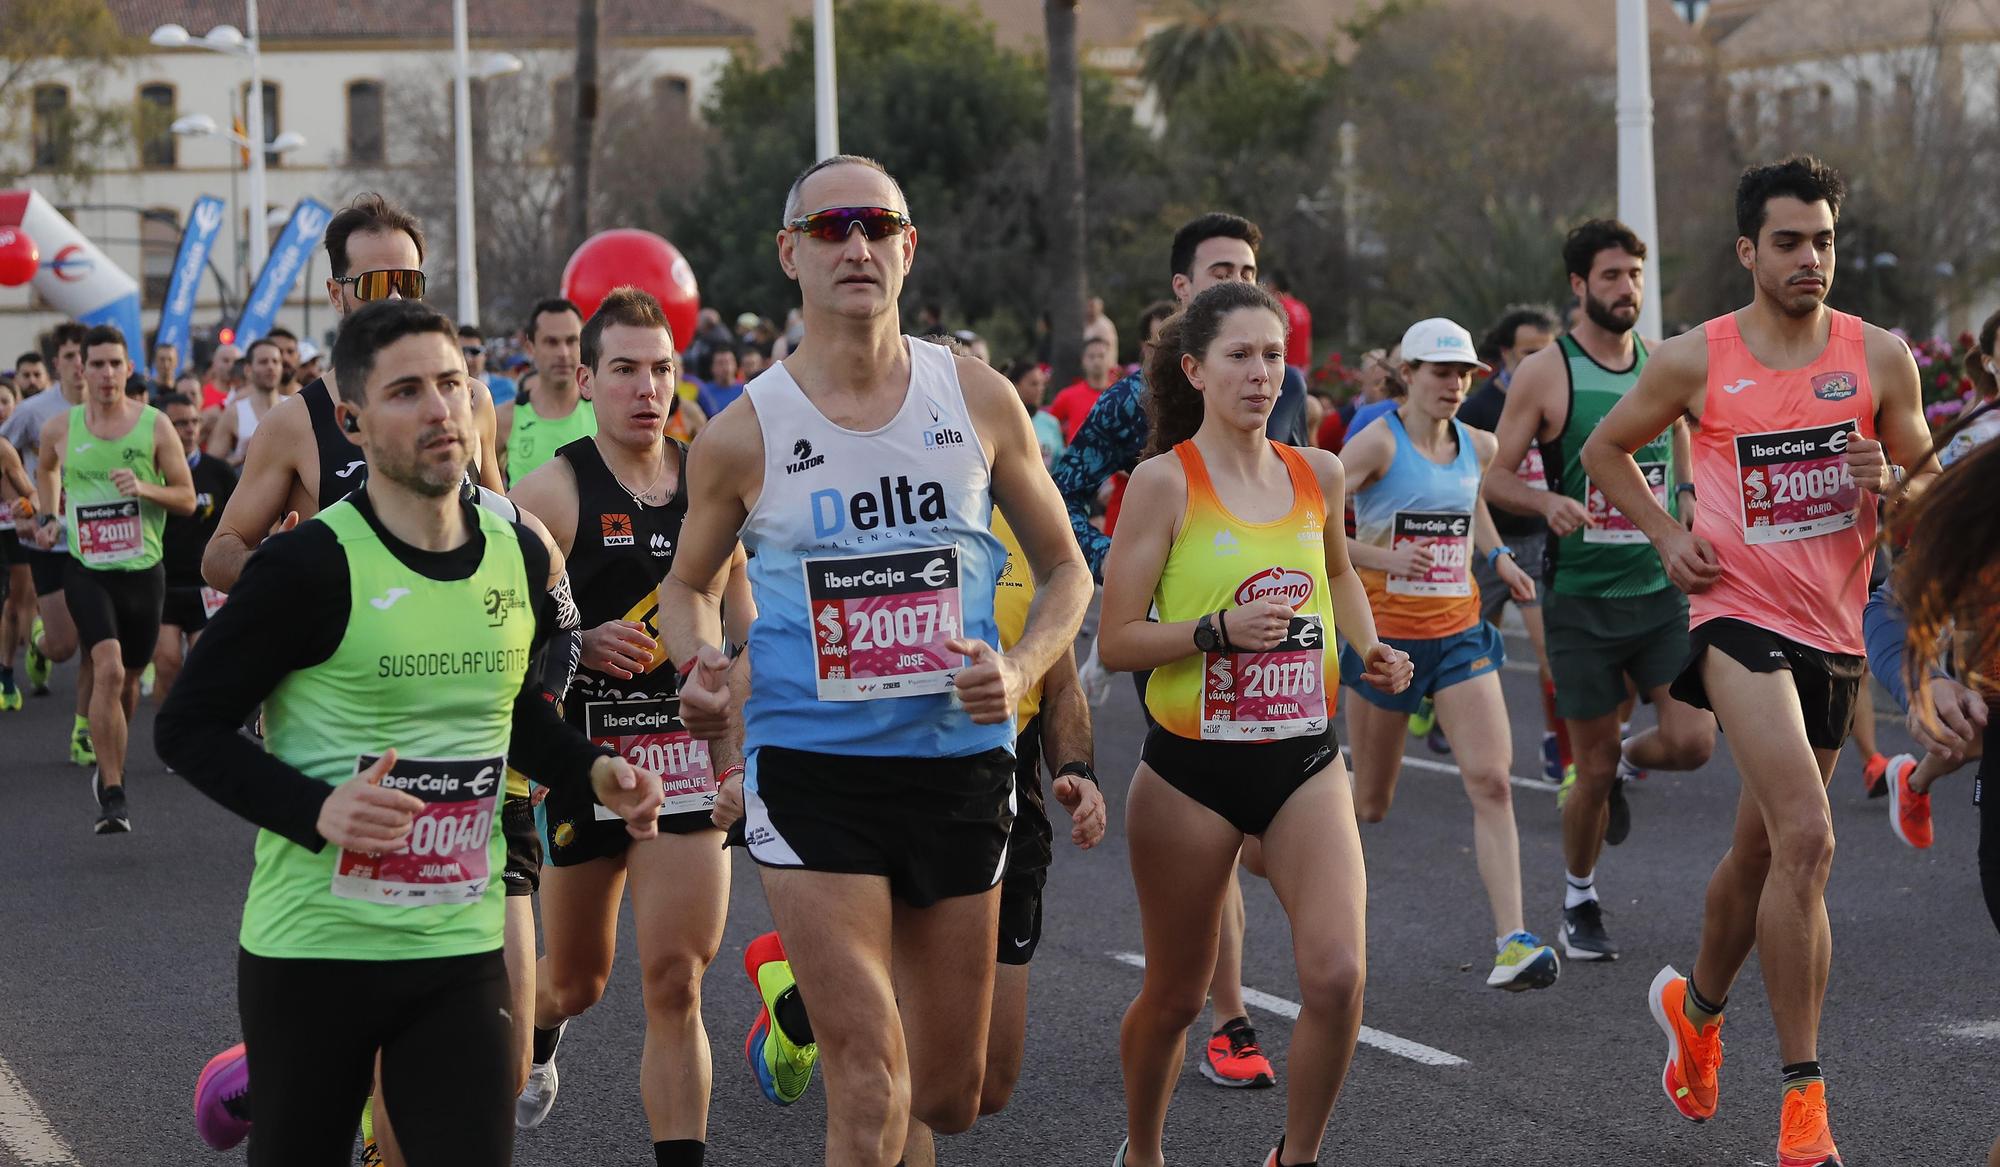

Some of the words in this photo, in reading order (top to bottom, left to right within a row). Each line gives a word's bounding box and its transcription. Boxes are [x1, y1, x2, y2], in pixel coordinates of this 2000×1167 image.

[923, 428, 963, 447] Delta
[1751, 439, 1815, 458] iberCaja
[786, 454, 825, 475] VIATOR
[1771, 462, 1855, 504] 20094
[810, 475, 947, 540] Delta
[1807, 503, 1832, 516] MARIO
[607, 537, 633, 545] VAPF
[818, 530, 915, 550] VALENCIA
[931, 525, 950, 533] CA
[824, 568, 905, 588] iberCaja
[1243, 583, 1308, 603] Serrano
[849, 602, 959, 651] 20074
[897, 653, 925, 668] JOSE
[1243, 661, 1316, 698] 20176
[1267, 702, 1299, 715] NATALIA
[603, 712, 668, 728] iberCaja
[629, 740, 708, 776] 20114
[378, 773, 459, 796] berCaja
[663, 776, 707, 792] UNNOLIFE
[419, 861, 462, 878] JUANMA
